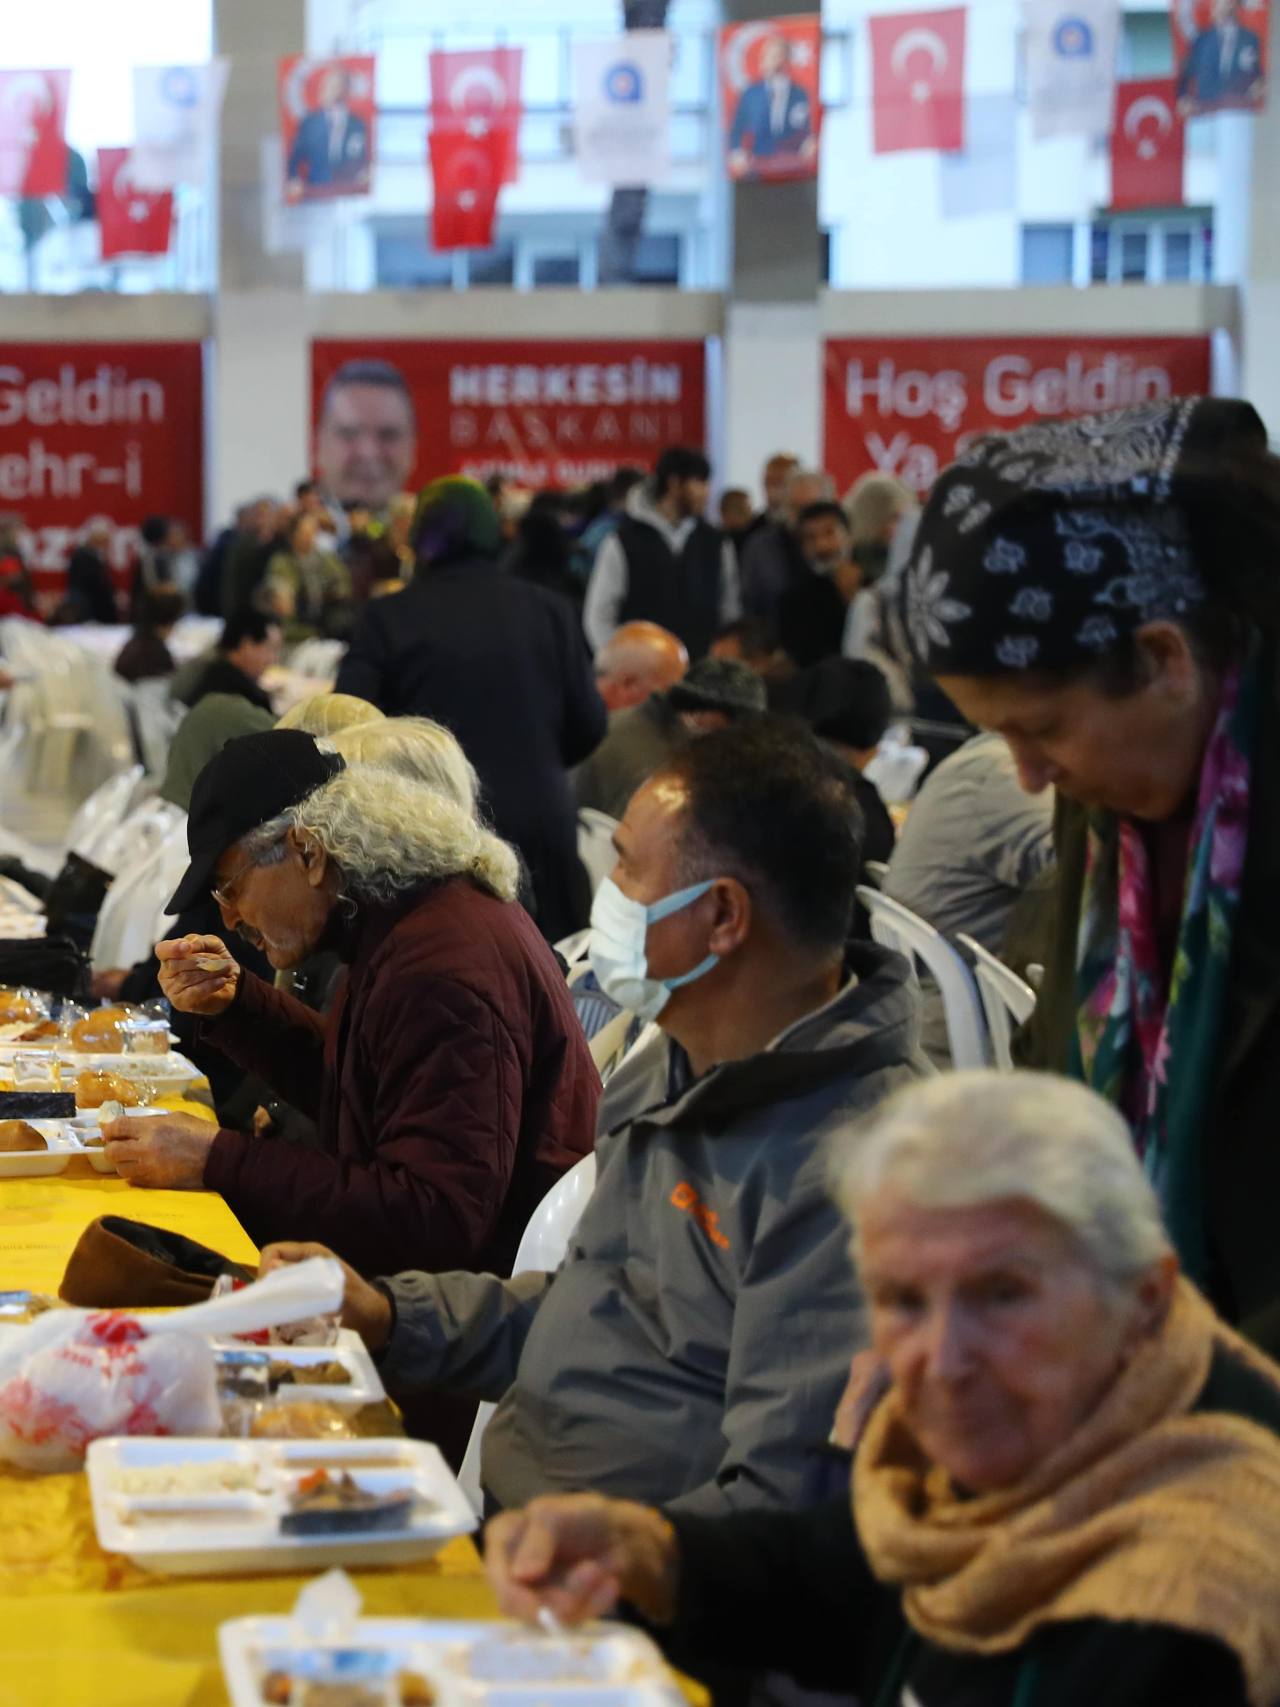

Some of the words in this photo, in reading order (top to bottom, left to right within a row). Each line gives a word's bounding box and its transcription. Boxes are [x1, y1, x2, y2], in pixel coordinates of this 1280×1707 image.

[450, 357, 682, 404] HERKESİN
[846, 358, 967, 431] Hoş
[983, 353, 1171, 416] Geldin
[865, 432, 938, 492] Ya
